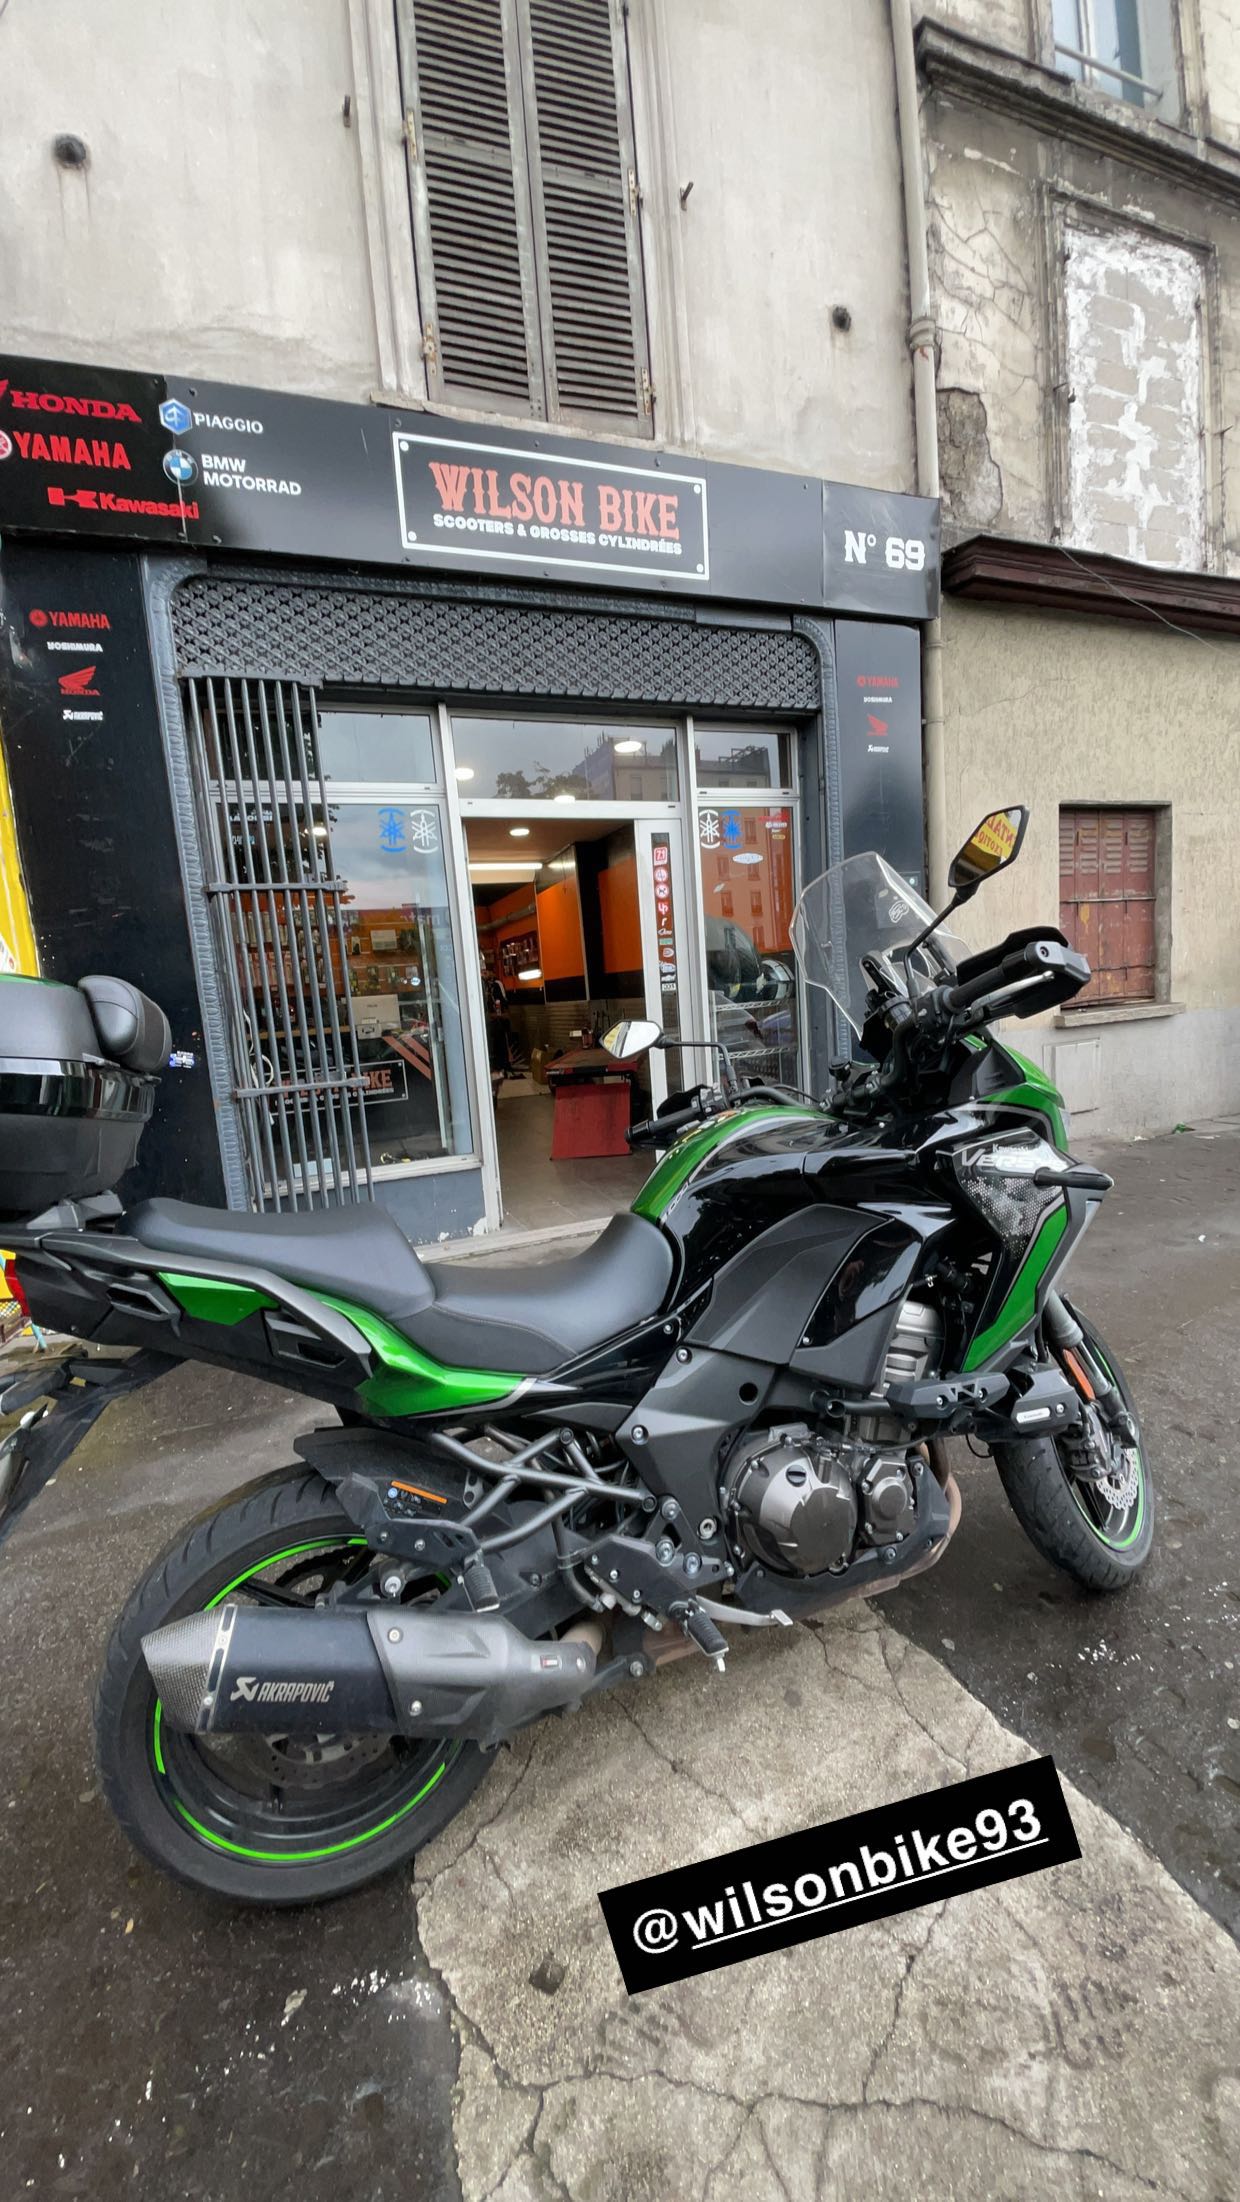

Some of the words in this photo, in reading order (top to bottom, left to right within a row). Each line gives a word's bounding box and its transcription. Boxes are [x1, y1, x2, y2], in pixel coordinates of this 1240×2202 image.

[10, 390, 143, 423] HONDA
[193, 412, 264, 434] PIAGGIO
[12, 431, 131, 471] YAMAHA
[201, 454, 246, 473] BMW
[203, 472, 302, 496] MOTORRAD
[100, 491, 199, 519] Kawasaki
[429, 462, 585, 527] WILSON
[598, 485, 680, 540] BIKE
[433, 513, 514, 535] SCOOTERS
[517, 525, 527, 537] &
[530, 526, 595, 545] GROSSES
[599, 534, 682, 555] CYLINDRÉES
[885, 537, 926, 571] 69
[48, 611, 112, 630] YAMAHA
